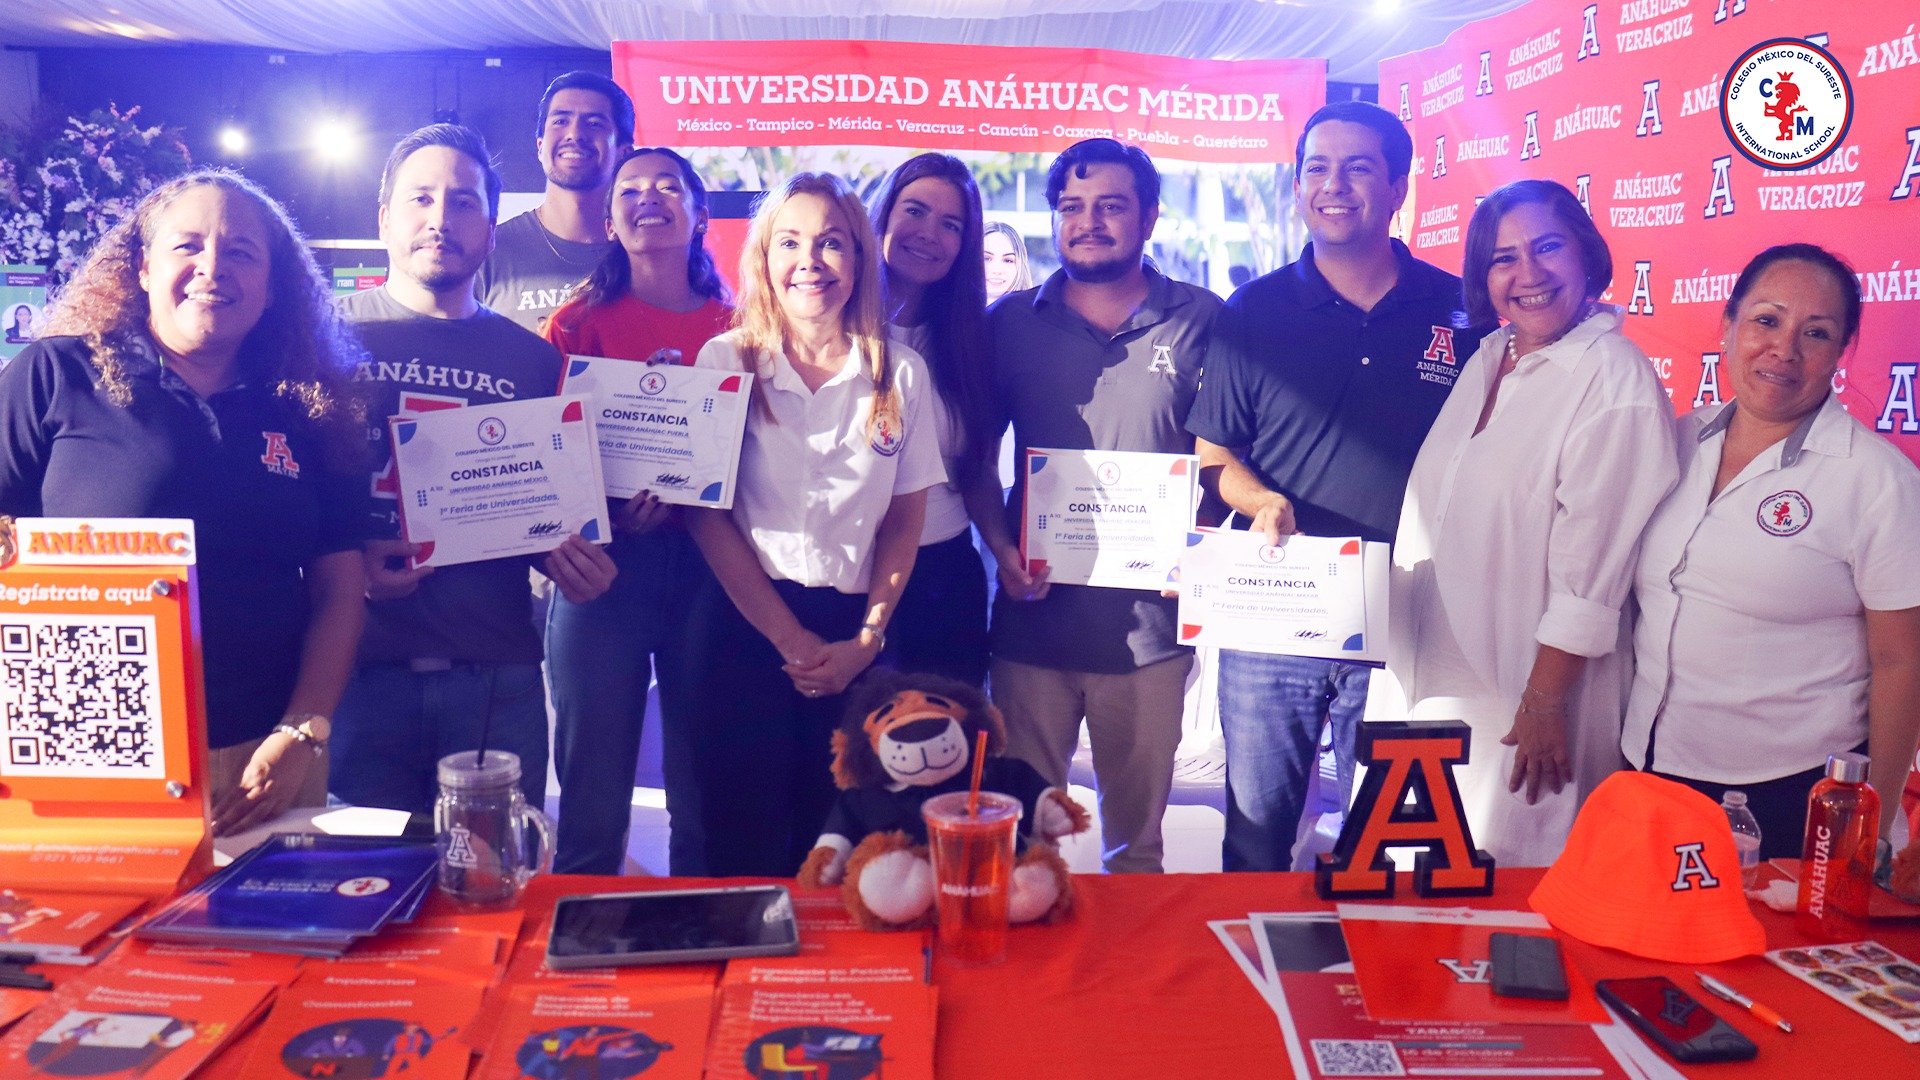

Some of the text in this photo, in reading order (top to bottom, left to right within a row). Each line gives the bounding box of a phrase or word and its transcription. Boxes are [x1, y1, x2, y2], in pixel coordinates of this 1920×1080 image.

[1507, 28, 1561, 67] ANÁHUAC
[1578, 4, 1600, 61] A
[1616, 13, 1693, 54] VERACRUZ
[1421, 64, 1463, 97] ANÁHUAC
[1476, 51, 1494, 97] A
[1506, 53, 1563, 91] VERACRUZ
[659, 73, 1284, 122] UNIVERSIDAD ANÁHUAC MÉRIDA
[1420, 85, 1465, 118] VERACRUZ
[1636, 79, 1662, 138] A
[677, 116, 1269, 150] México Tampico Mérida Veracruz Cancún Oaxaca Puebla Querétaro
[1520, 111, 1541, 162] A
[1552, 103, 1622, 141] ANÁHUAC
[1432, 135, 1447, 179] A
[1456, 134, 1510, 163] ANÁHUAC
[1613, 171, 1683, 200] ANÁHUAC
[1704, 155, 1736, 219] A
[1758, 181, 1866, 212] VERACRUZ
[1420, 201, 1459, 229] ANÁHUAC
[1609, 202, 1685, 228] VERACRUZ
[1416, 225, 1460, 249] VERACRUZ
[1628, 261, 1654, 315] A
[1148, 344, 1177, 375] A
[1424, 325, 1457, 366] A
[352, 358, 516, 400] ANÁHUAC
[1416, 360, 1460, 378] ANÁHUAC
[1420, 371, 1454, 387] MÉRIDA
[602, 408, 689, 427] CONSTANCIA
[260, 431, 300, 473] A
[615, 441, 627, 449] de
[449, 475, 548, 494] UNIVERSIDAD ANÁHUAC MÉXICO
[450, 460, 544, 482] CONSTANCIA
[450, 504, 474, 514] Feria
[475, 502, 489, 511] de
[1068, 503, 1147, 514] CONSTANCIA
[28, 524, 191, 557] ANÁHUAC
[1063, 532, 1084, 540] Feria
[1085, 532, 1096, 541] de
[105, 586, 153, 605] aquí
[1227, 576, 1316, 589] CONSTANCIA
[1221, 603, 1245, 611] Feria
[1246, 604, 1259, 612] de
[1314, 719, 1496, 900] A
[1671, 842, 1719, 891] A
[1809, 825, 1831, 919] ANÁHUAC
